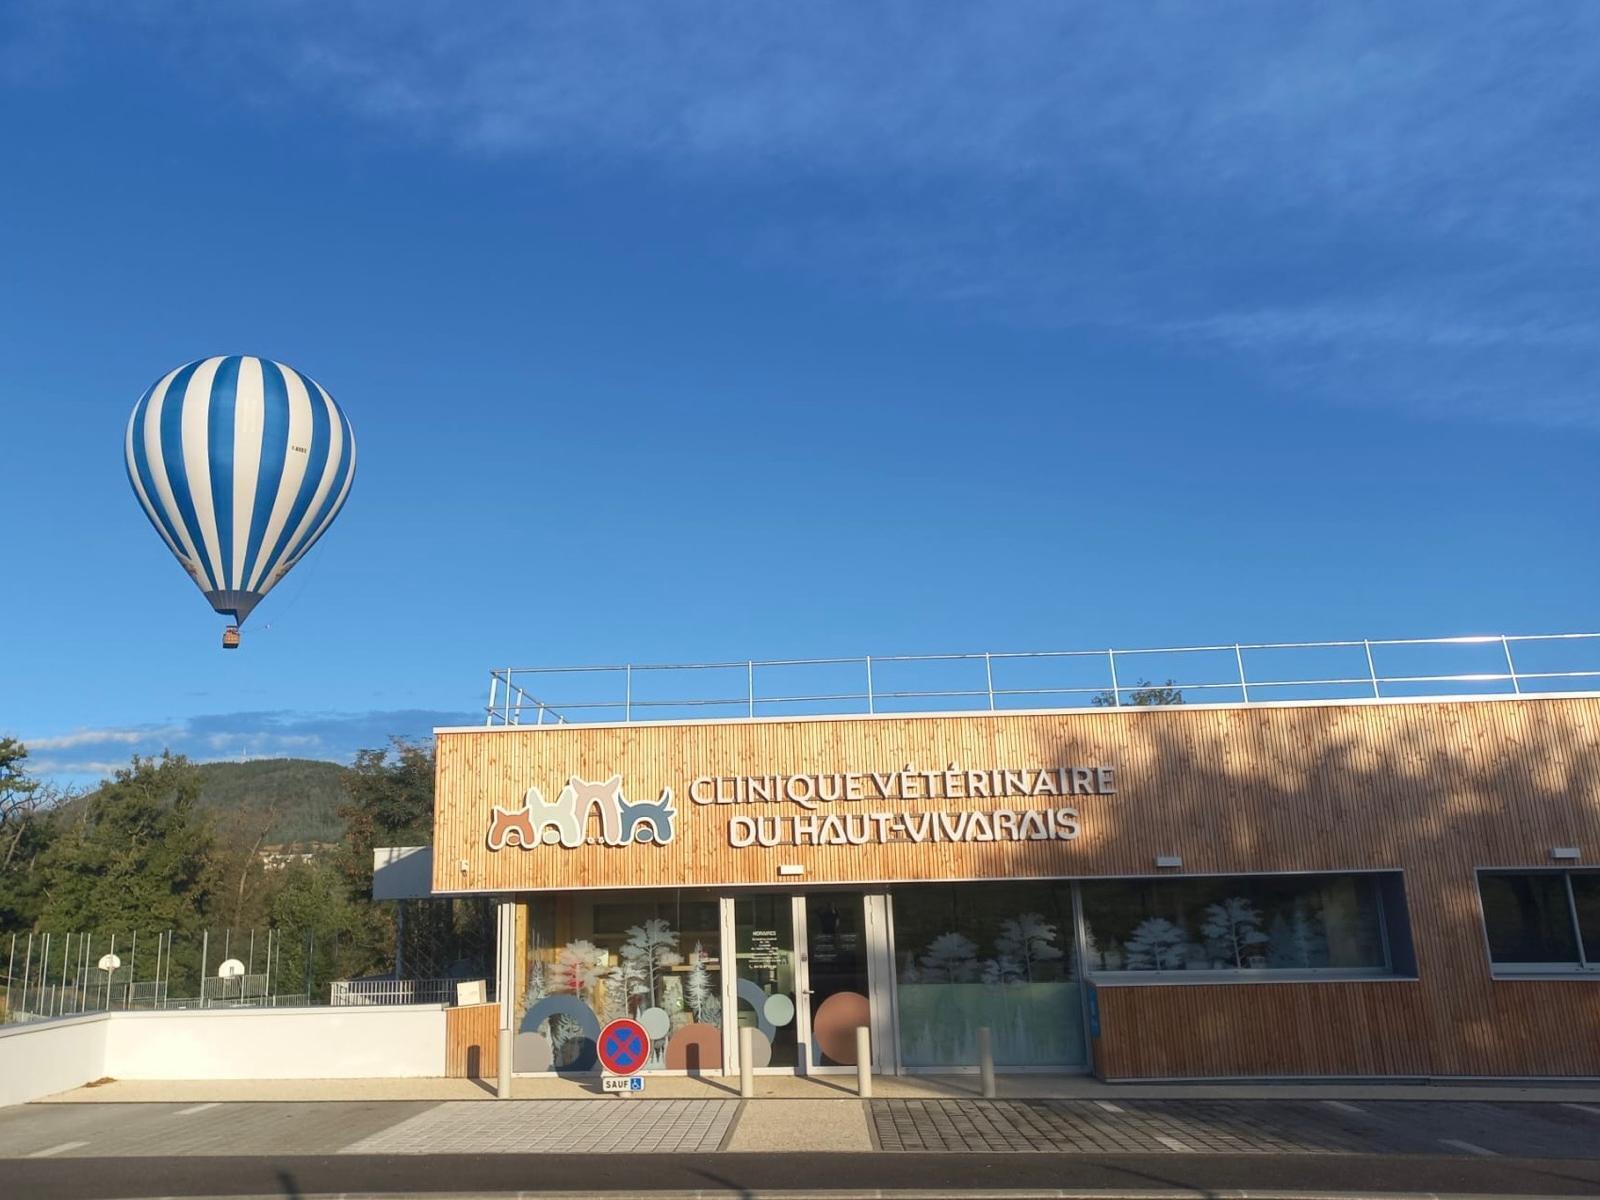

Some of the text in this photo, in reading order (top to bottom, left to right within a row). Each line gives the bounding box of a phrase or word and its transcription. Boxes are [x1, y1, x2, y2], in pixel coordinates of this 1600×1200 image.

[689, 764, 1118, 809] CLINIQUE VÉTÉRINAIRE
[728, 808, 1081, 848] DU HAUT-VIVARAIS
[606, 1080, 629, 1089] SAUF
